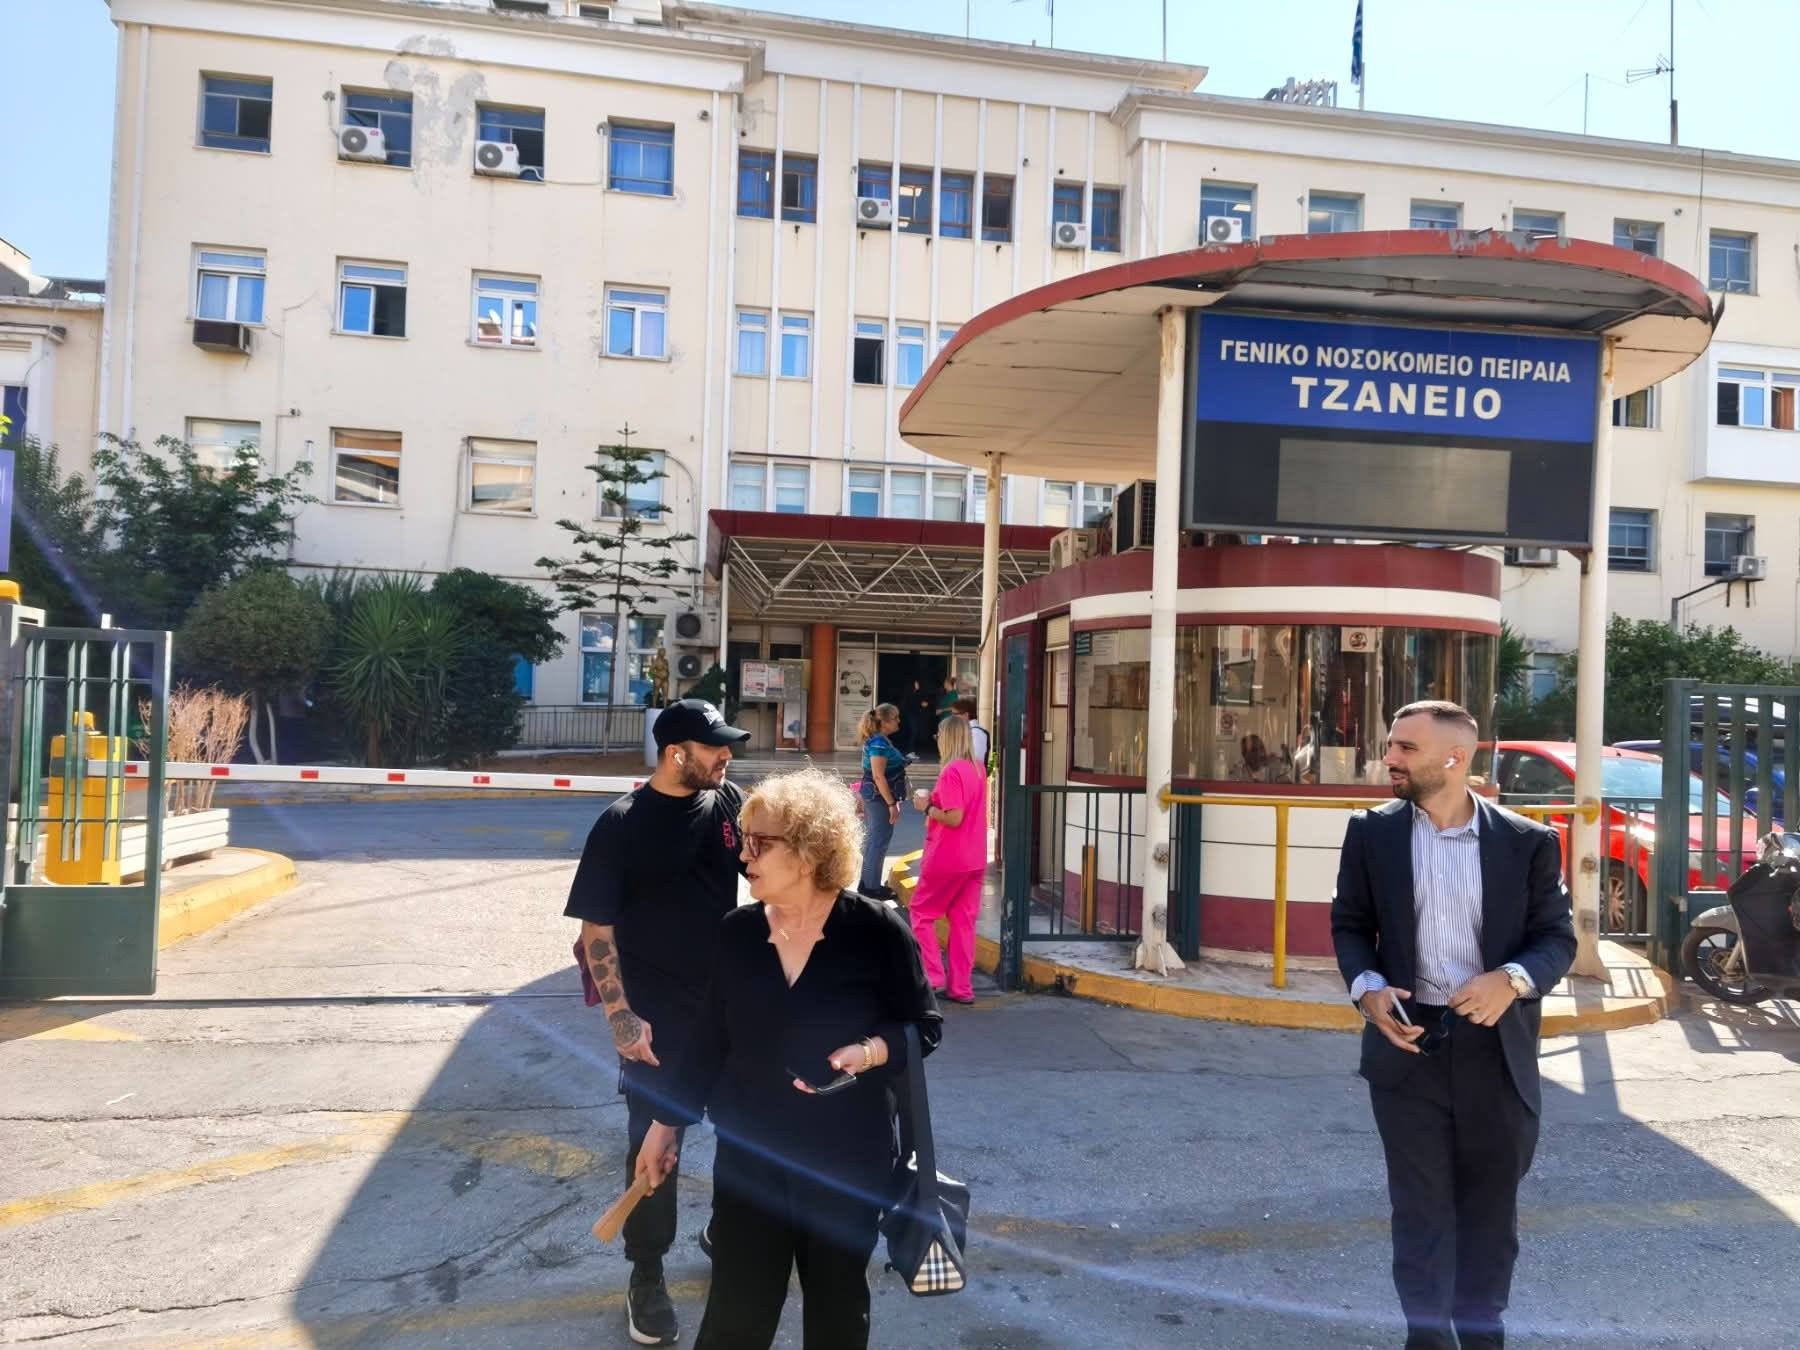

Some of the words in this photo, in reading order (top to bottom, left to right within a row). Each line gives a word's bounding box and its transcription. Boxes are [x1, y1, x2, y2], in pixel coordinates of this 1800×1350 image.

[1220, 339, 1309, 366] ΓΕΝΙΚΟ
[1316, 346, 1473, 377] ΝΟΣΟΚΟΜΕΙΟ
[1480, 357, 1571, 384] ΠΕΙΡΑΙΑ
[1291, 376, 1502, 420] ΤΖΑΝΕΙΟ
